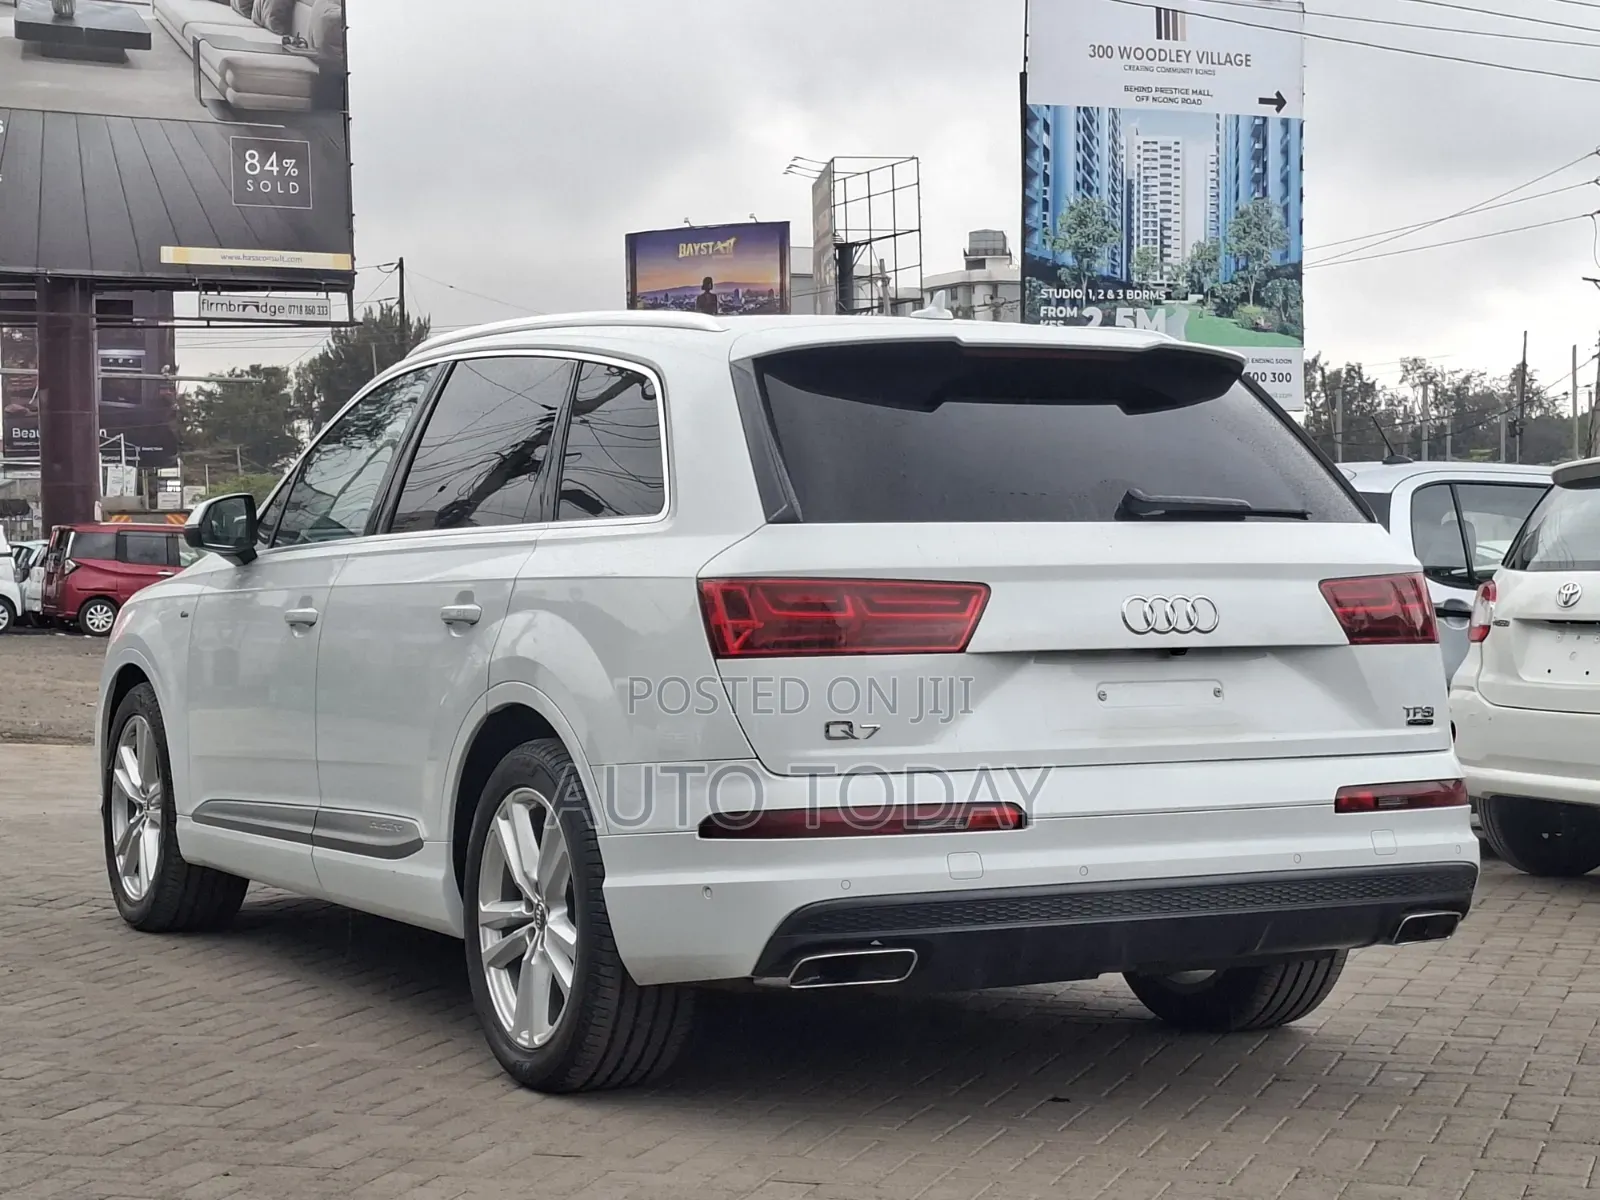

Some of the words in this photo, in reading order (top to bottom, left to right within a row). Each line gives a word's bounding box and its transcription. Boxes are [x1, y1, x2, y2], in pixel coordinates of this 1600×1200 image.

[1088, 44, 1114, 59] 300
[1118, 46, 1192, 63] WOODLEY
[1196, 50, 1252, 68] VILLAGE
[1123, 64, 1155, 73] CREATING
[1155, 66, 1194, 74] COMMUNITY
[1123, 85, 1153, 93] BEHIND
[1154, 86, 1190, 95] PRESTIGE
[1151, 96, 1180, 104] NGONG
[245, 149, 298, 175] 84%
[246, 179, 300, 194] SOLD
[1040, 288, 1086, 301] STUDIO,
[1088, 289, 1095, 301] 1,
[1098, 289, 1105, 299] 2
[1106, 289, 1115, 300] &
[1116, 289, 1124, 300] 3
[1126, 290, 1166, 300] BDRMS
[1040, 306, 1078, 318] FROM
[1081, 306, 1166, 333] 25M
[1245, 371, 1267, 382] 00
[1270, 372, 1292, 383] 300
[824, 720, 881, 740] Q7
